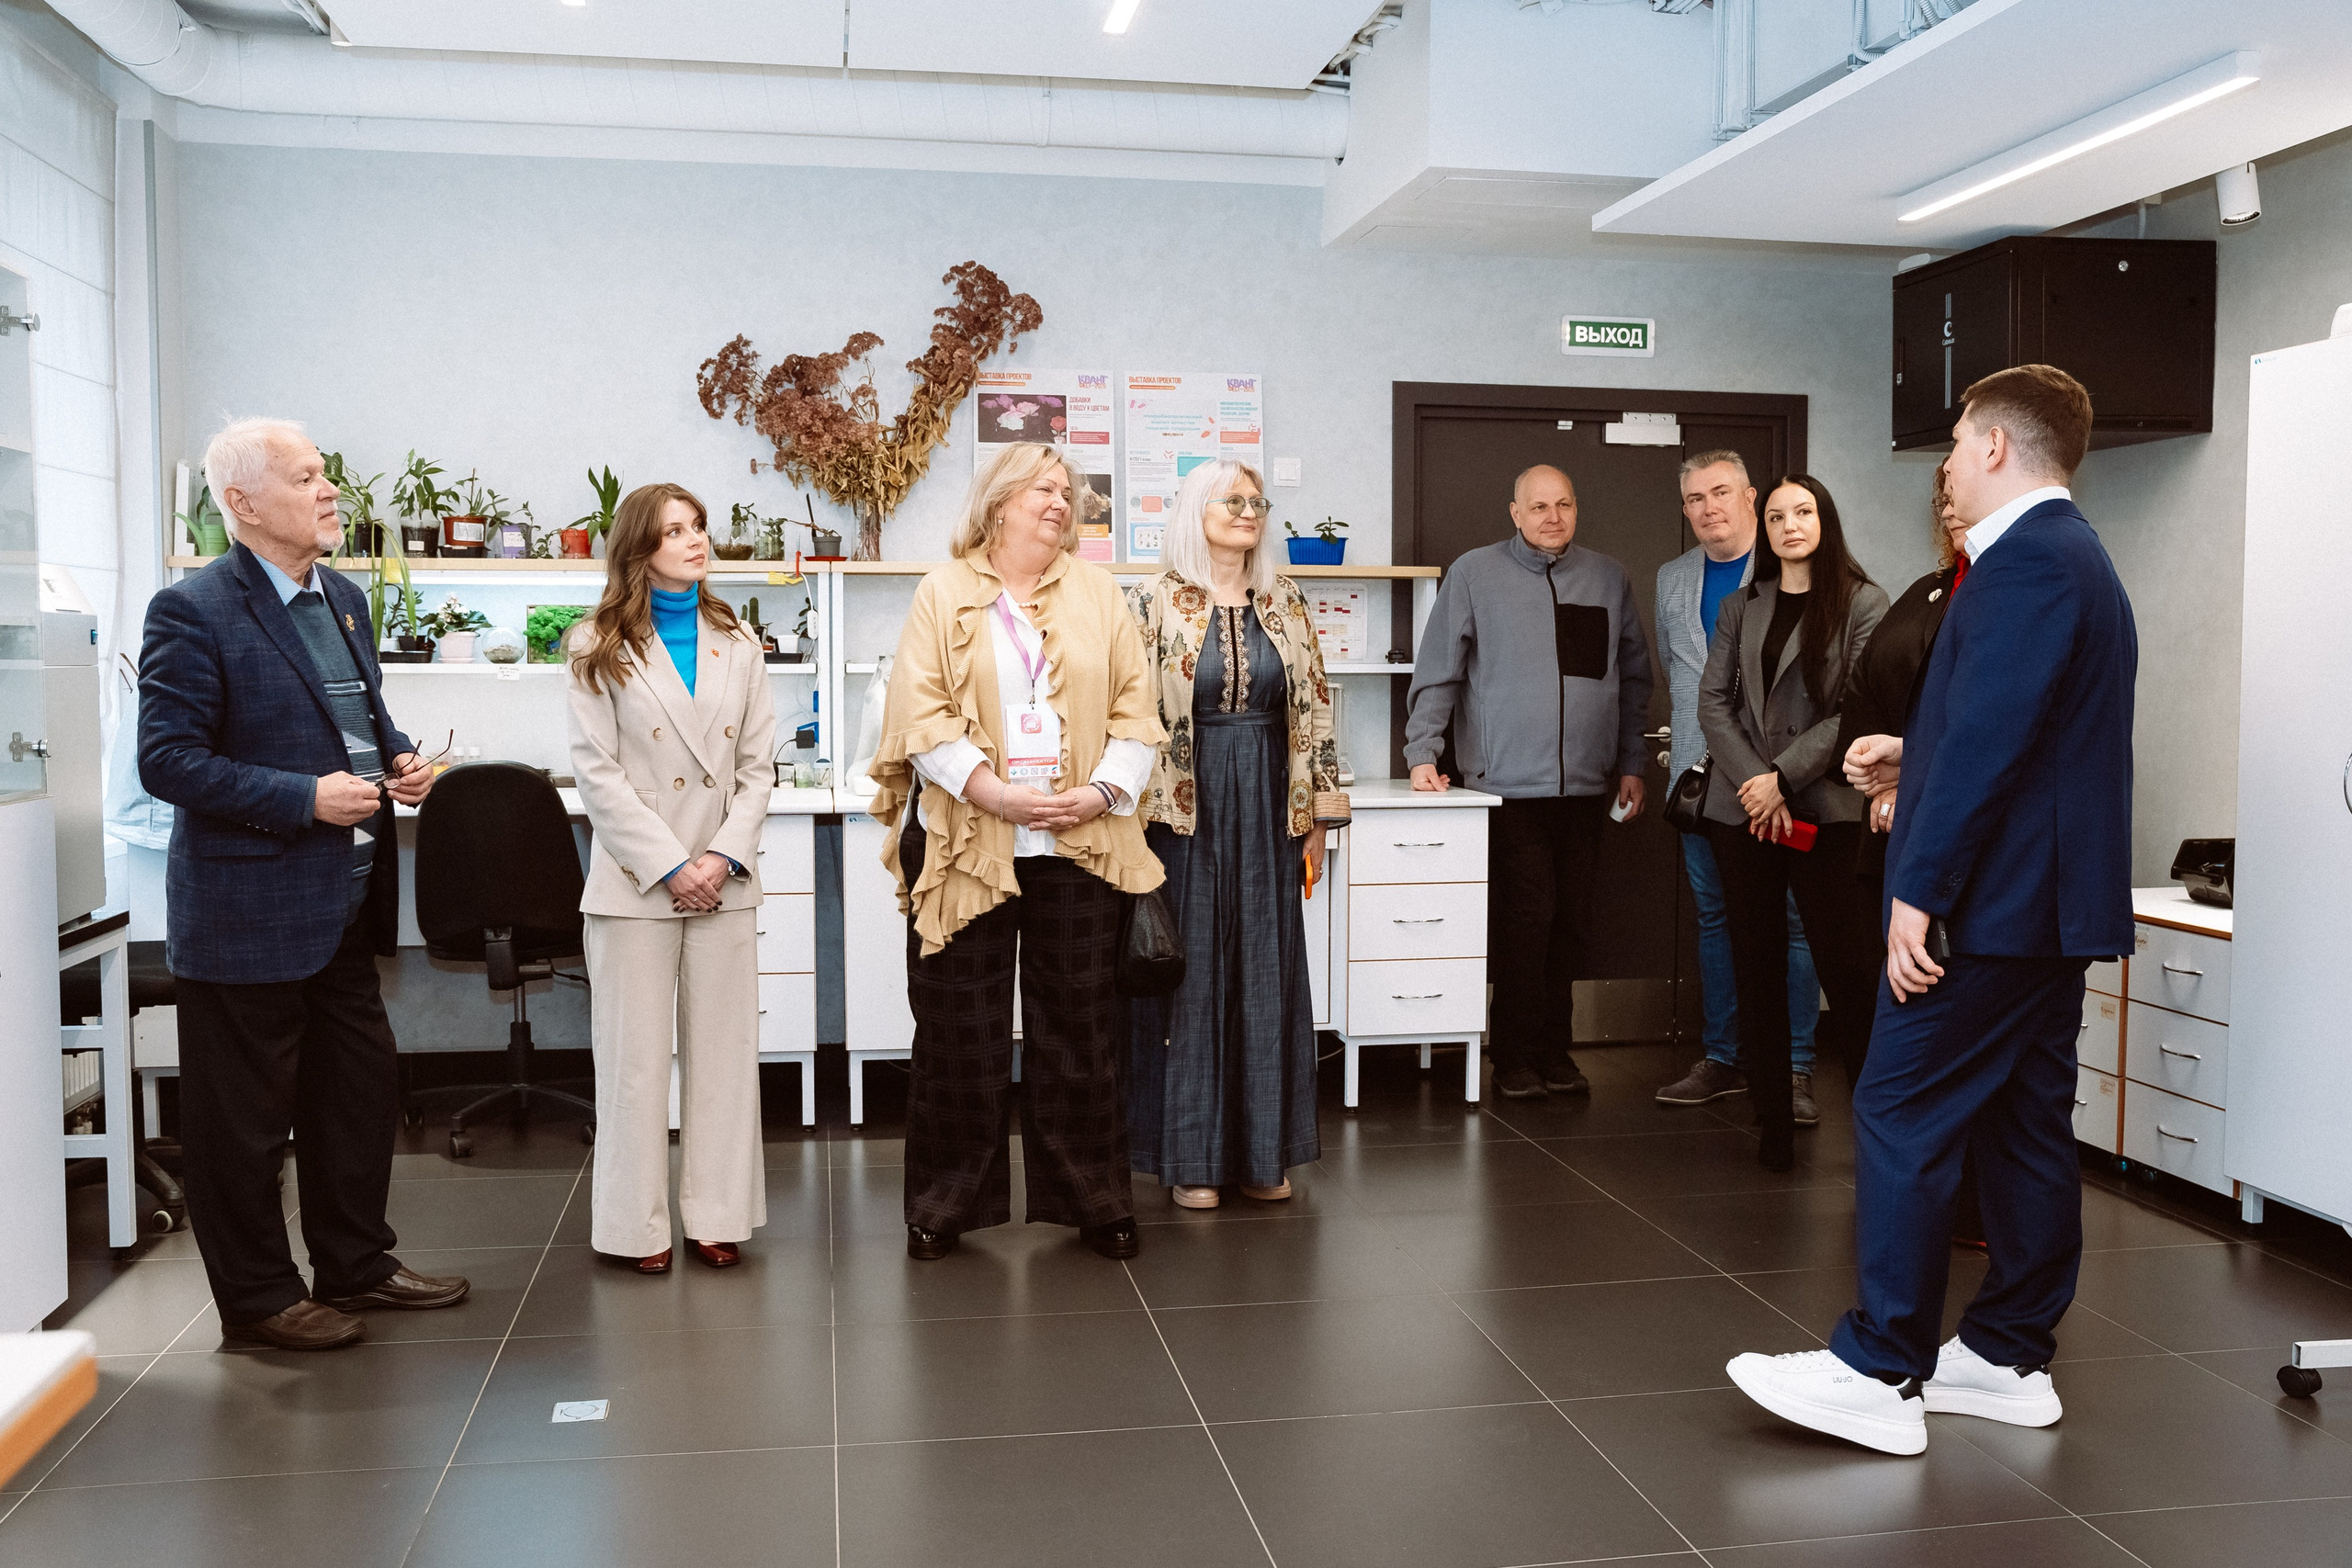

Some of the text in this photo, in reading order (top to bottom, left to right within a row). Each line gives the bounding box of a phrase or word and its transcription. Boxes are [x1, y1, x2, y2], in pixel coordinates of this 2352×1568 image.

[1575, 325, 1643, 347] ВЫХОД
[1078, 375, 1108, 384] КВАНТ
[1227, 378, 1257, 388] КВАНТ
